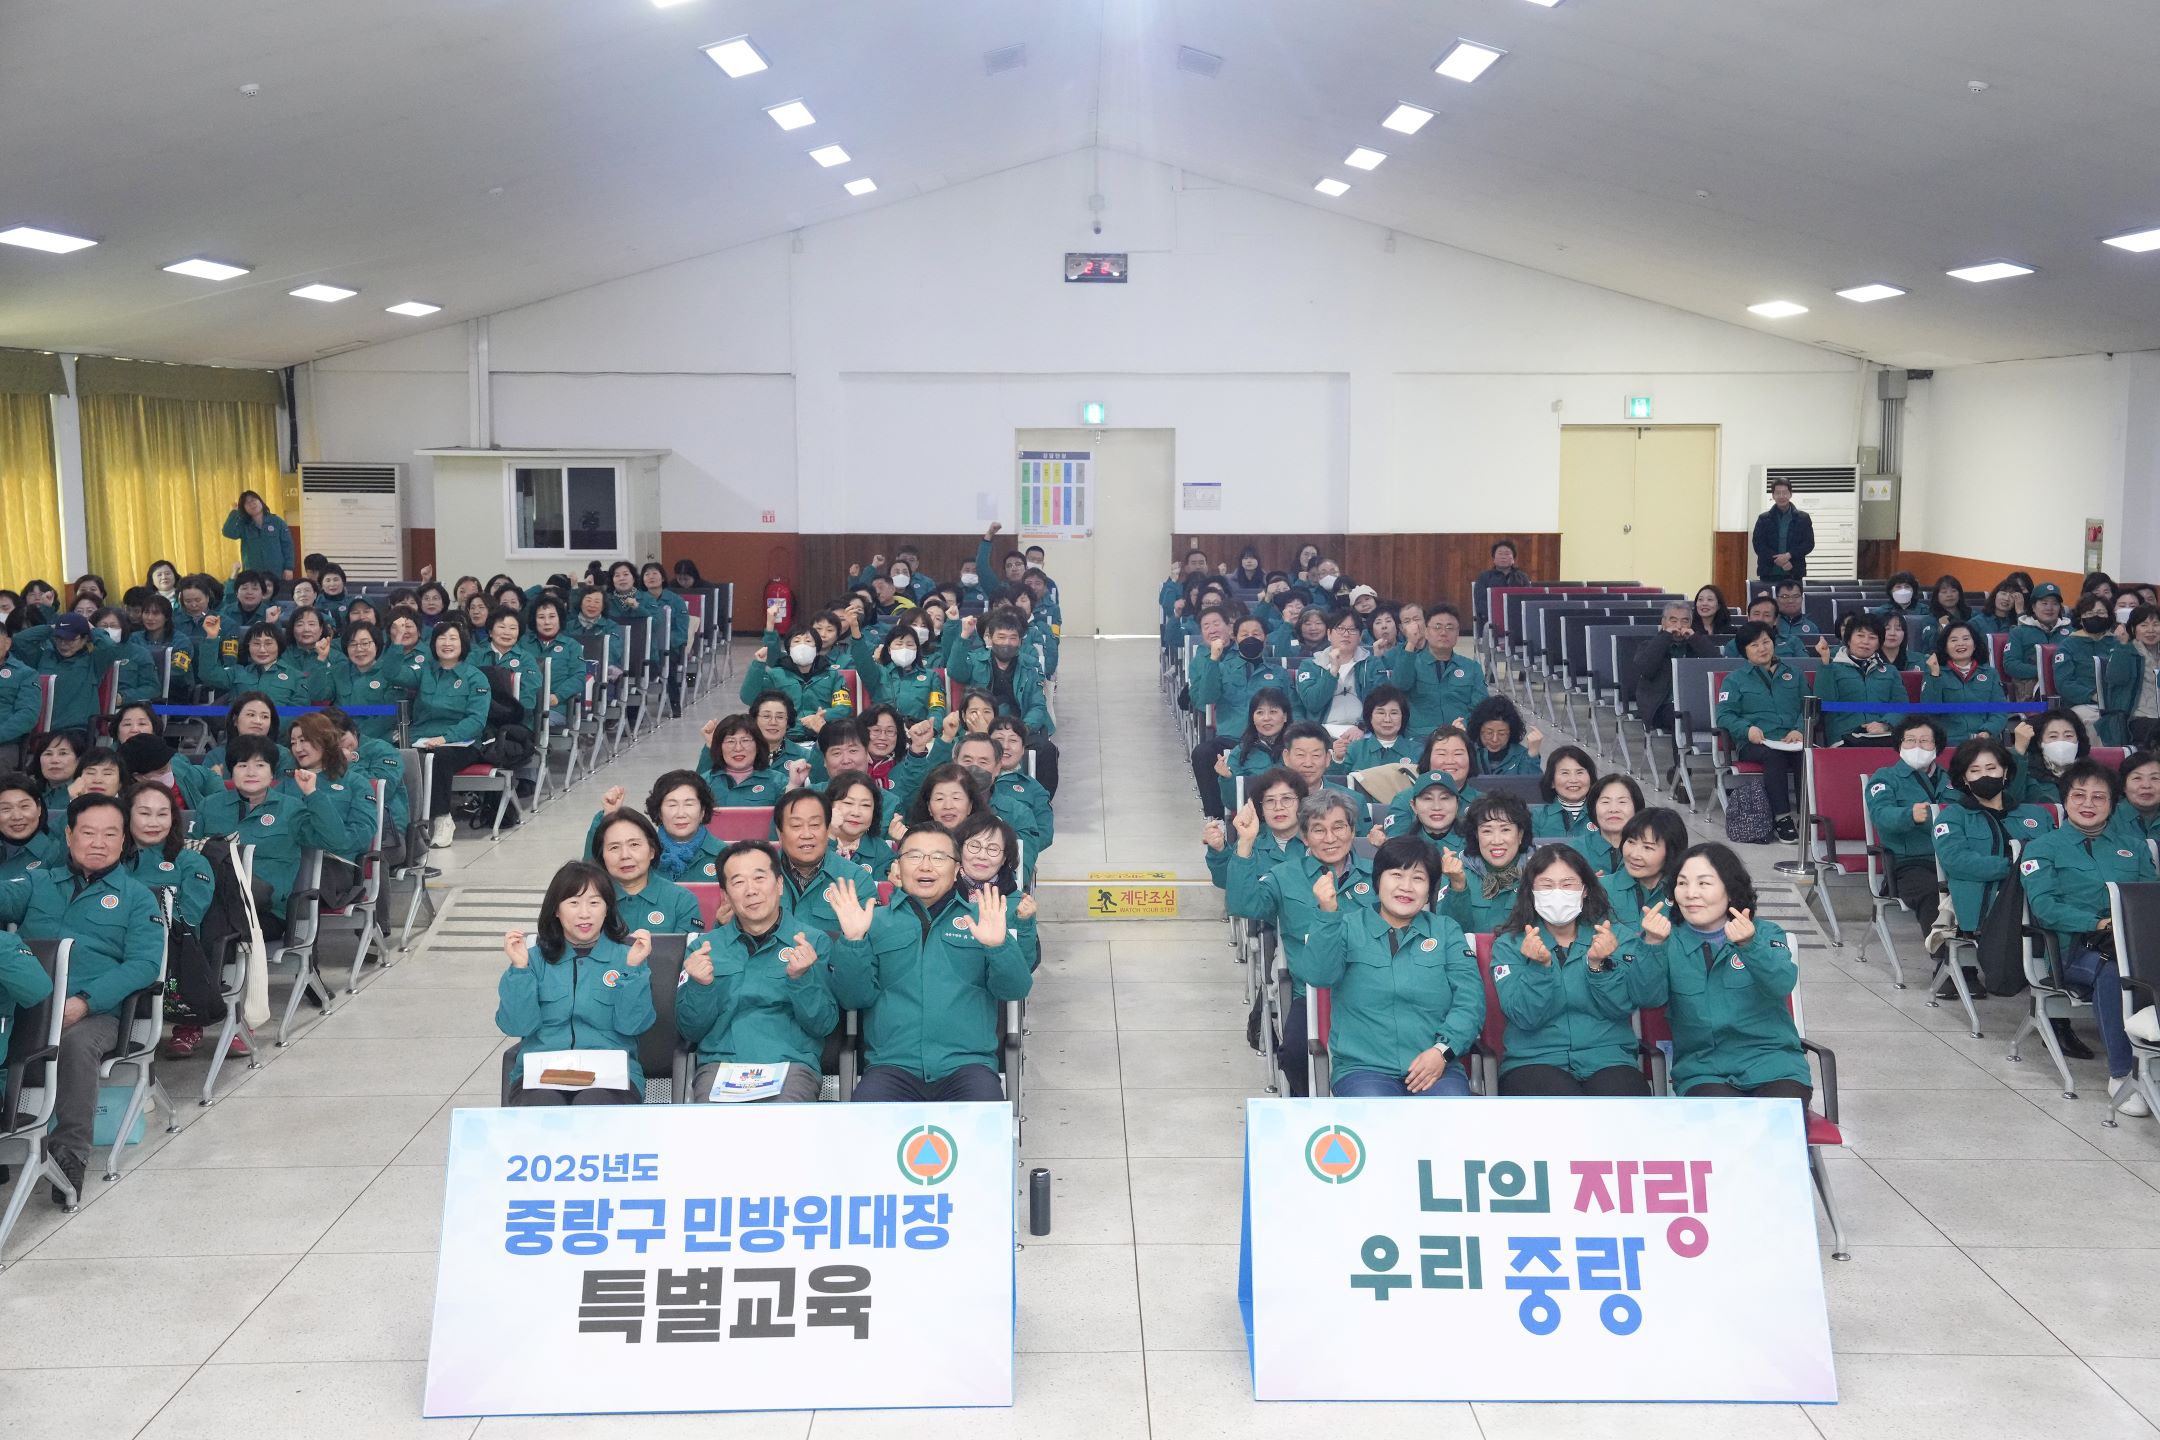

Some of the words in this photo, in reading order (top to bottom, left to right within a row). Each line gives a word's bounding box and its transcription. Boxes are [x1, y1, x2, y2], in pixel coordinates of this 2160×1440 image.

[1120, 890, 1175, 906] 계단조심
[507, 1153, 658, 1183] 2025년도
[505, 1199, 666, 1255] 중랑구
[684, 1193, 953, 1253] 민방위대장
[1418, 1160, 1550, 1214] 나의
[1570, 1161, 1712, 1259] 자랑
[579, 1265, 872, 1343] 특별교육
[1351, 1235, 1483, 1301] 우리
[1505, 1237, 1645, 1336] 중랑
